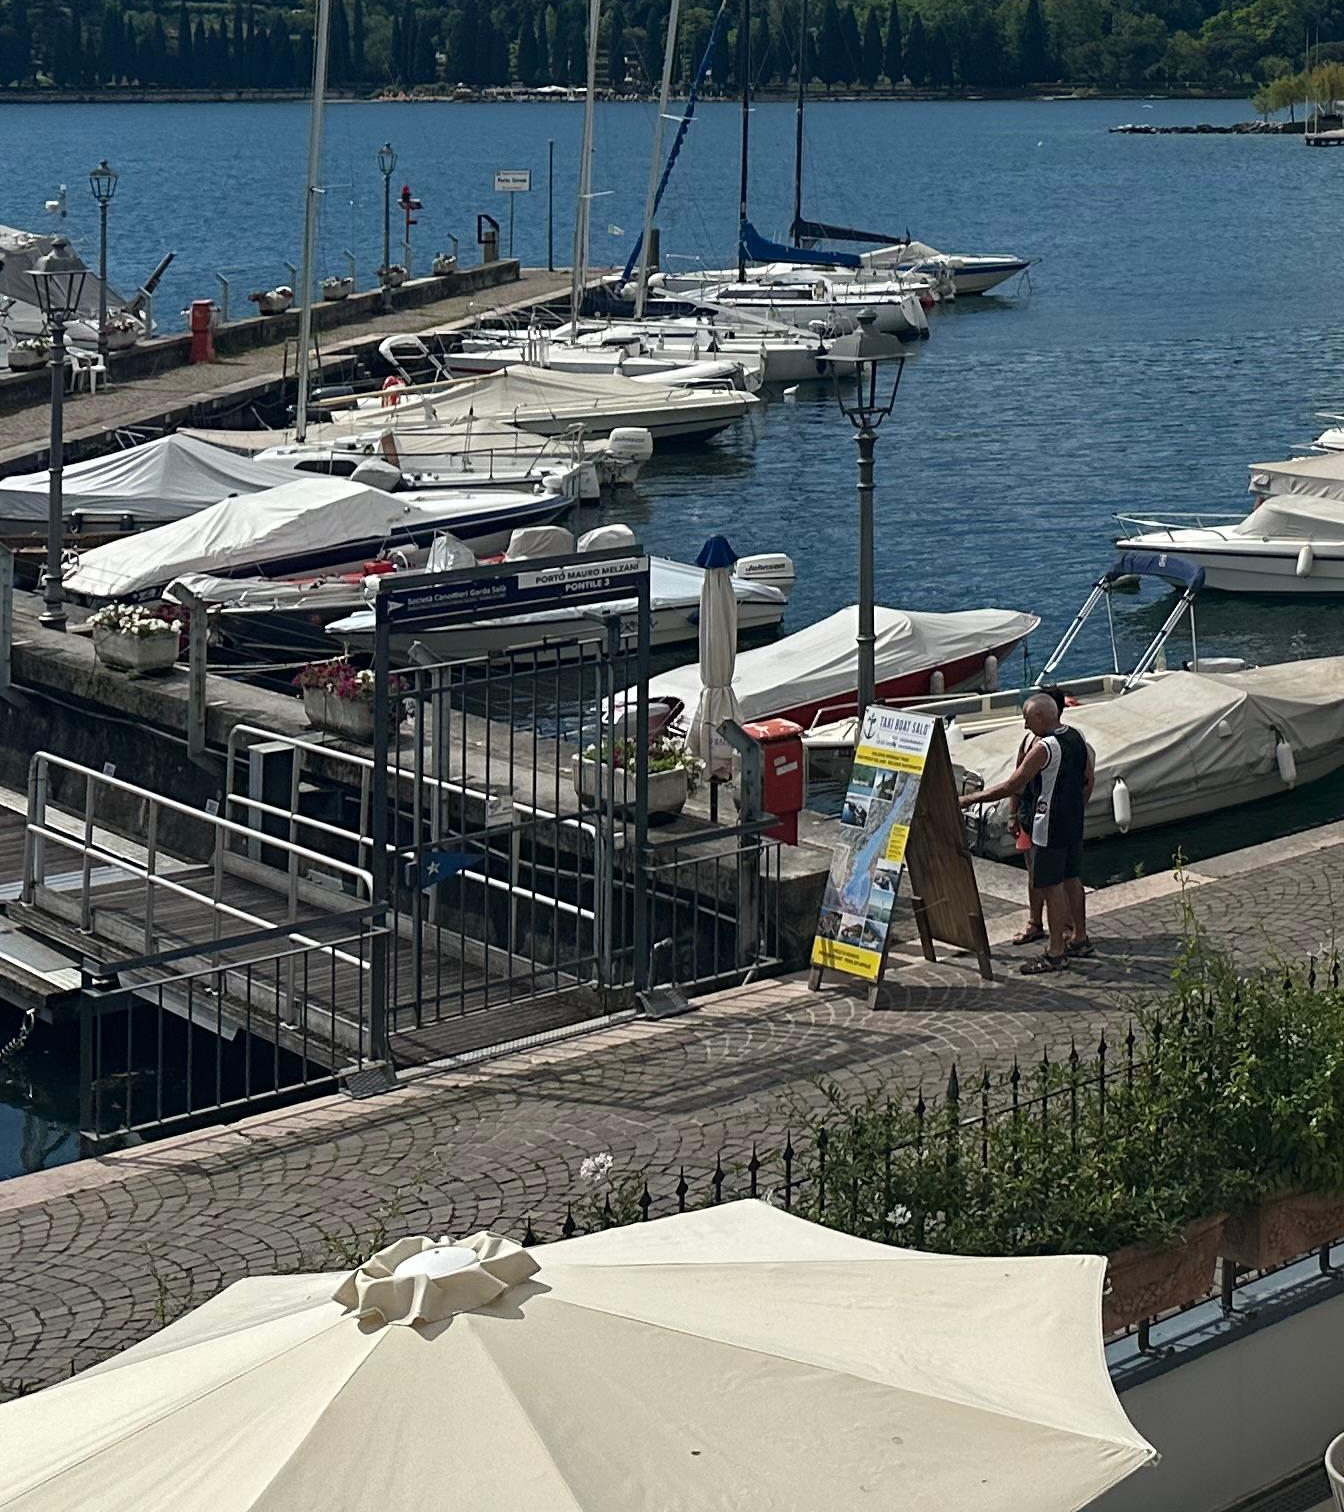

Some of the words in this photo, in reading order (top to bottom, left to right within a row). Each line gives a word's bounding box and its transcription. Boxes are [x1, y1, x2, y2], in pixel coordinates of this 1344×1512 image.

[535, 573, 566, 585] PORTO
[567, 568, 600, 579] MAURO
[601, 563, 639, 574] MELZANI
[565, 579, 603, 592] PONTILE
[603, 577, 611, 586] 3
[880, 716, 894, 729] TAXI
[894, 718, 912, 732] BOAT
